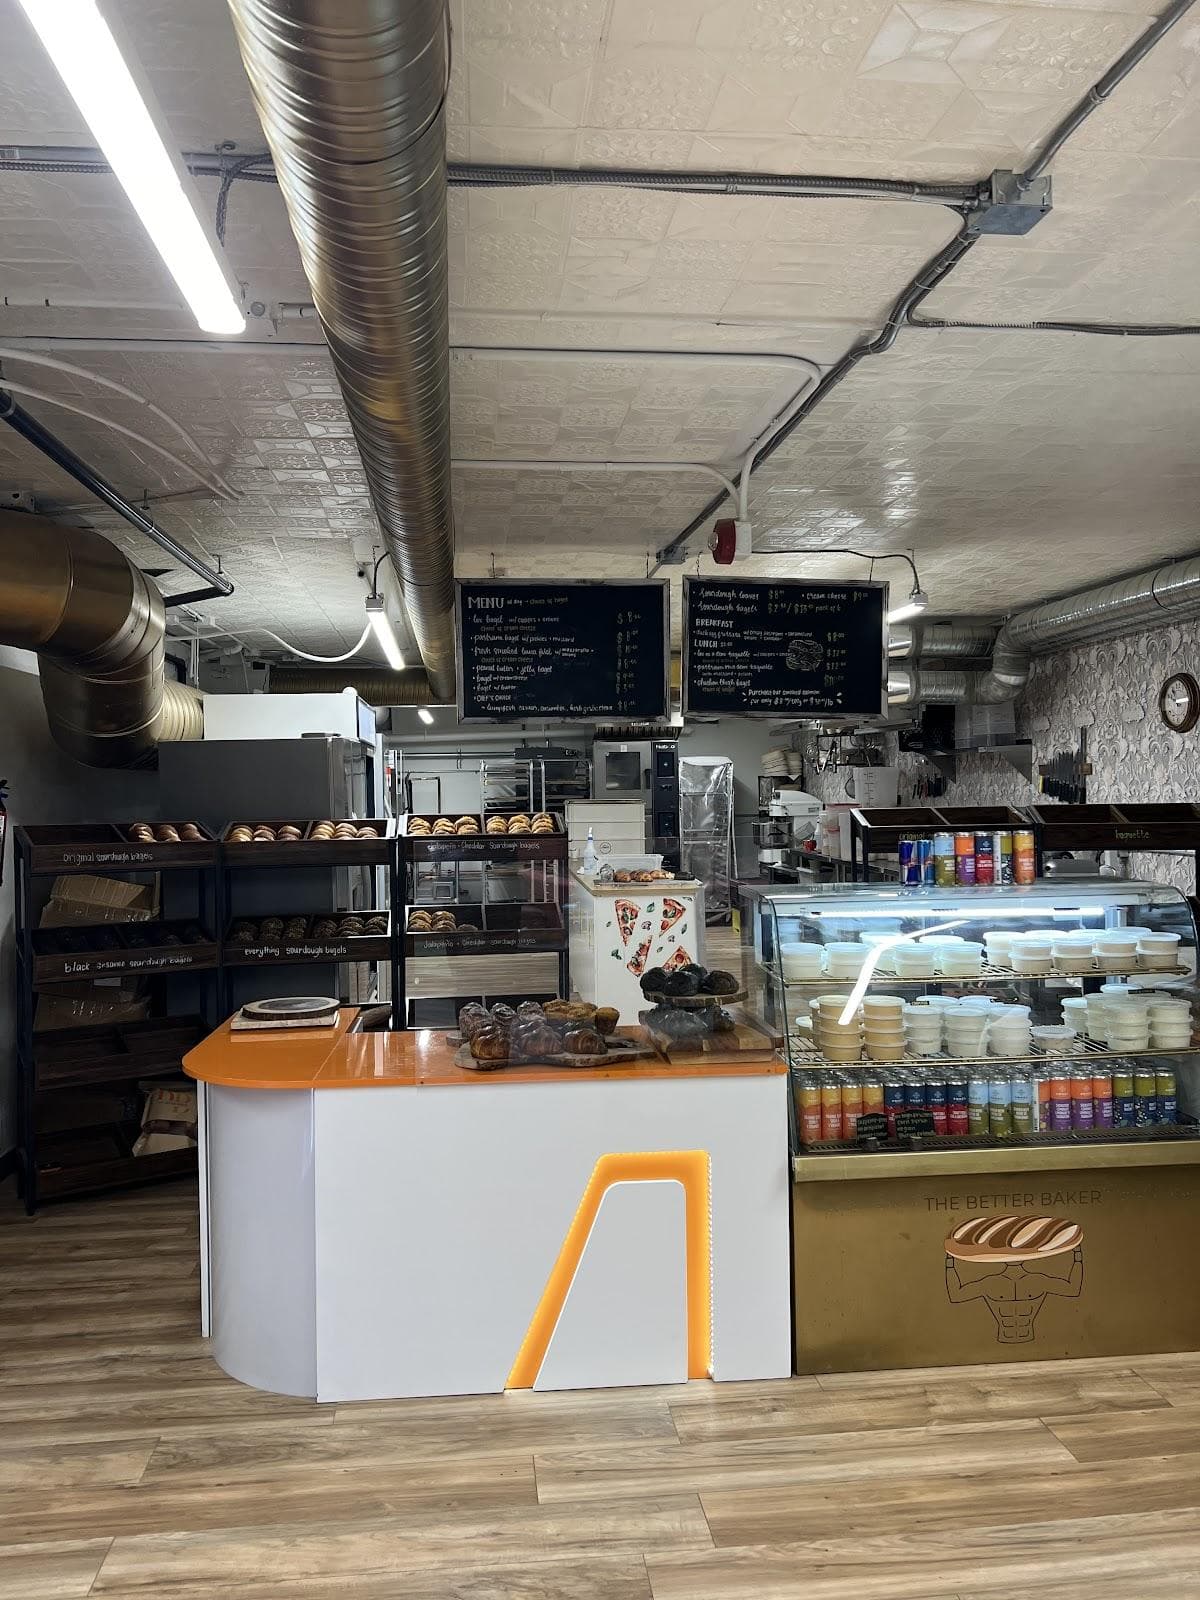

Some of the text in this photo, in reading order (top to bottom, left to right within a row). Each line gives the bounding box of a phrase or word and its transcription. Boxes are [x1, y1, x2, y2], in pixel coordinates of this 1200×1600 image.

[467, 596, 505, 609] MENU
[486, 614, 503, 626] bagel
[695, 618, 734, 628] BREAKFAST
[504, 634, 520, 644] bagel
[693, 639, 718, 648] LUNCH
[537, 665, 553, 675] bagel
[476, 674, 493, 684] bagel
[63, 852, 95, 866] Original
[244, 945, 347, 958] everything sourdough bagels
[64, 962, 90, 973] black
[926, 1190, 1103, 1211] THE BETTER BAKER
